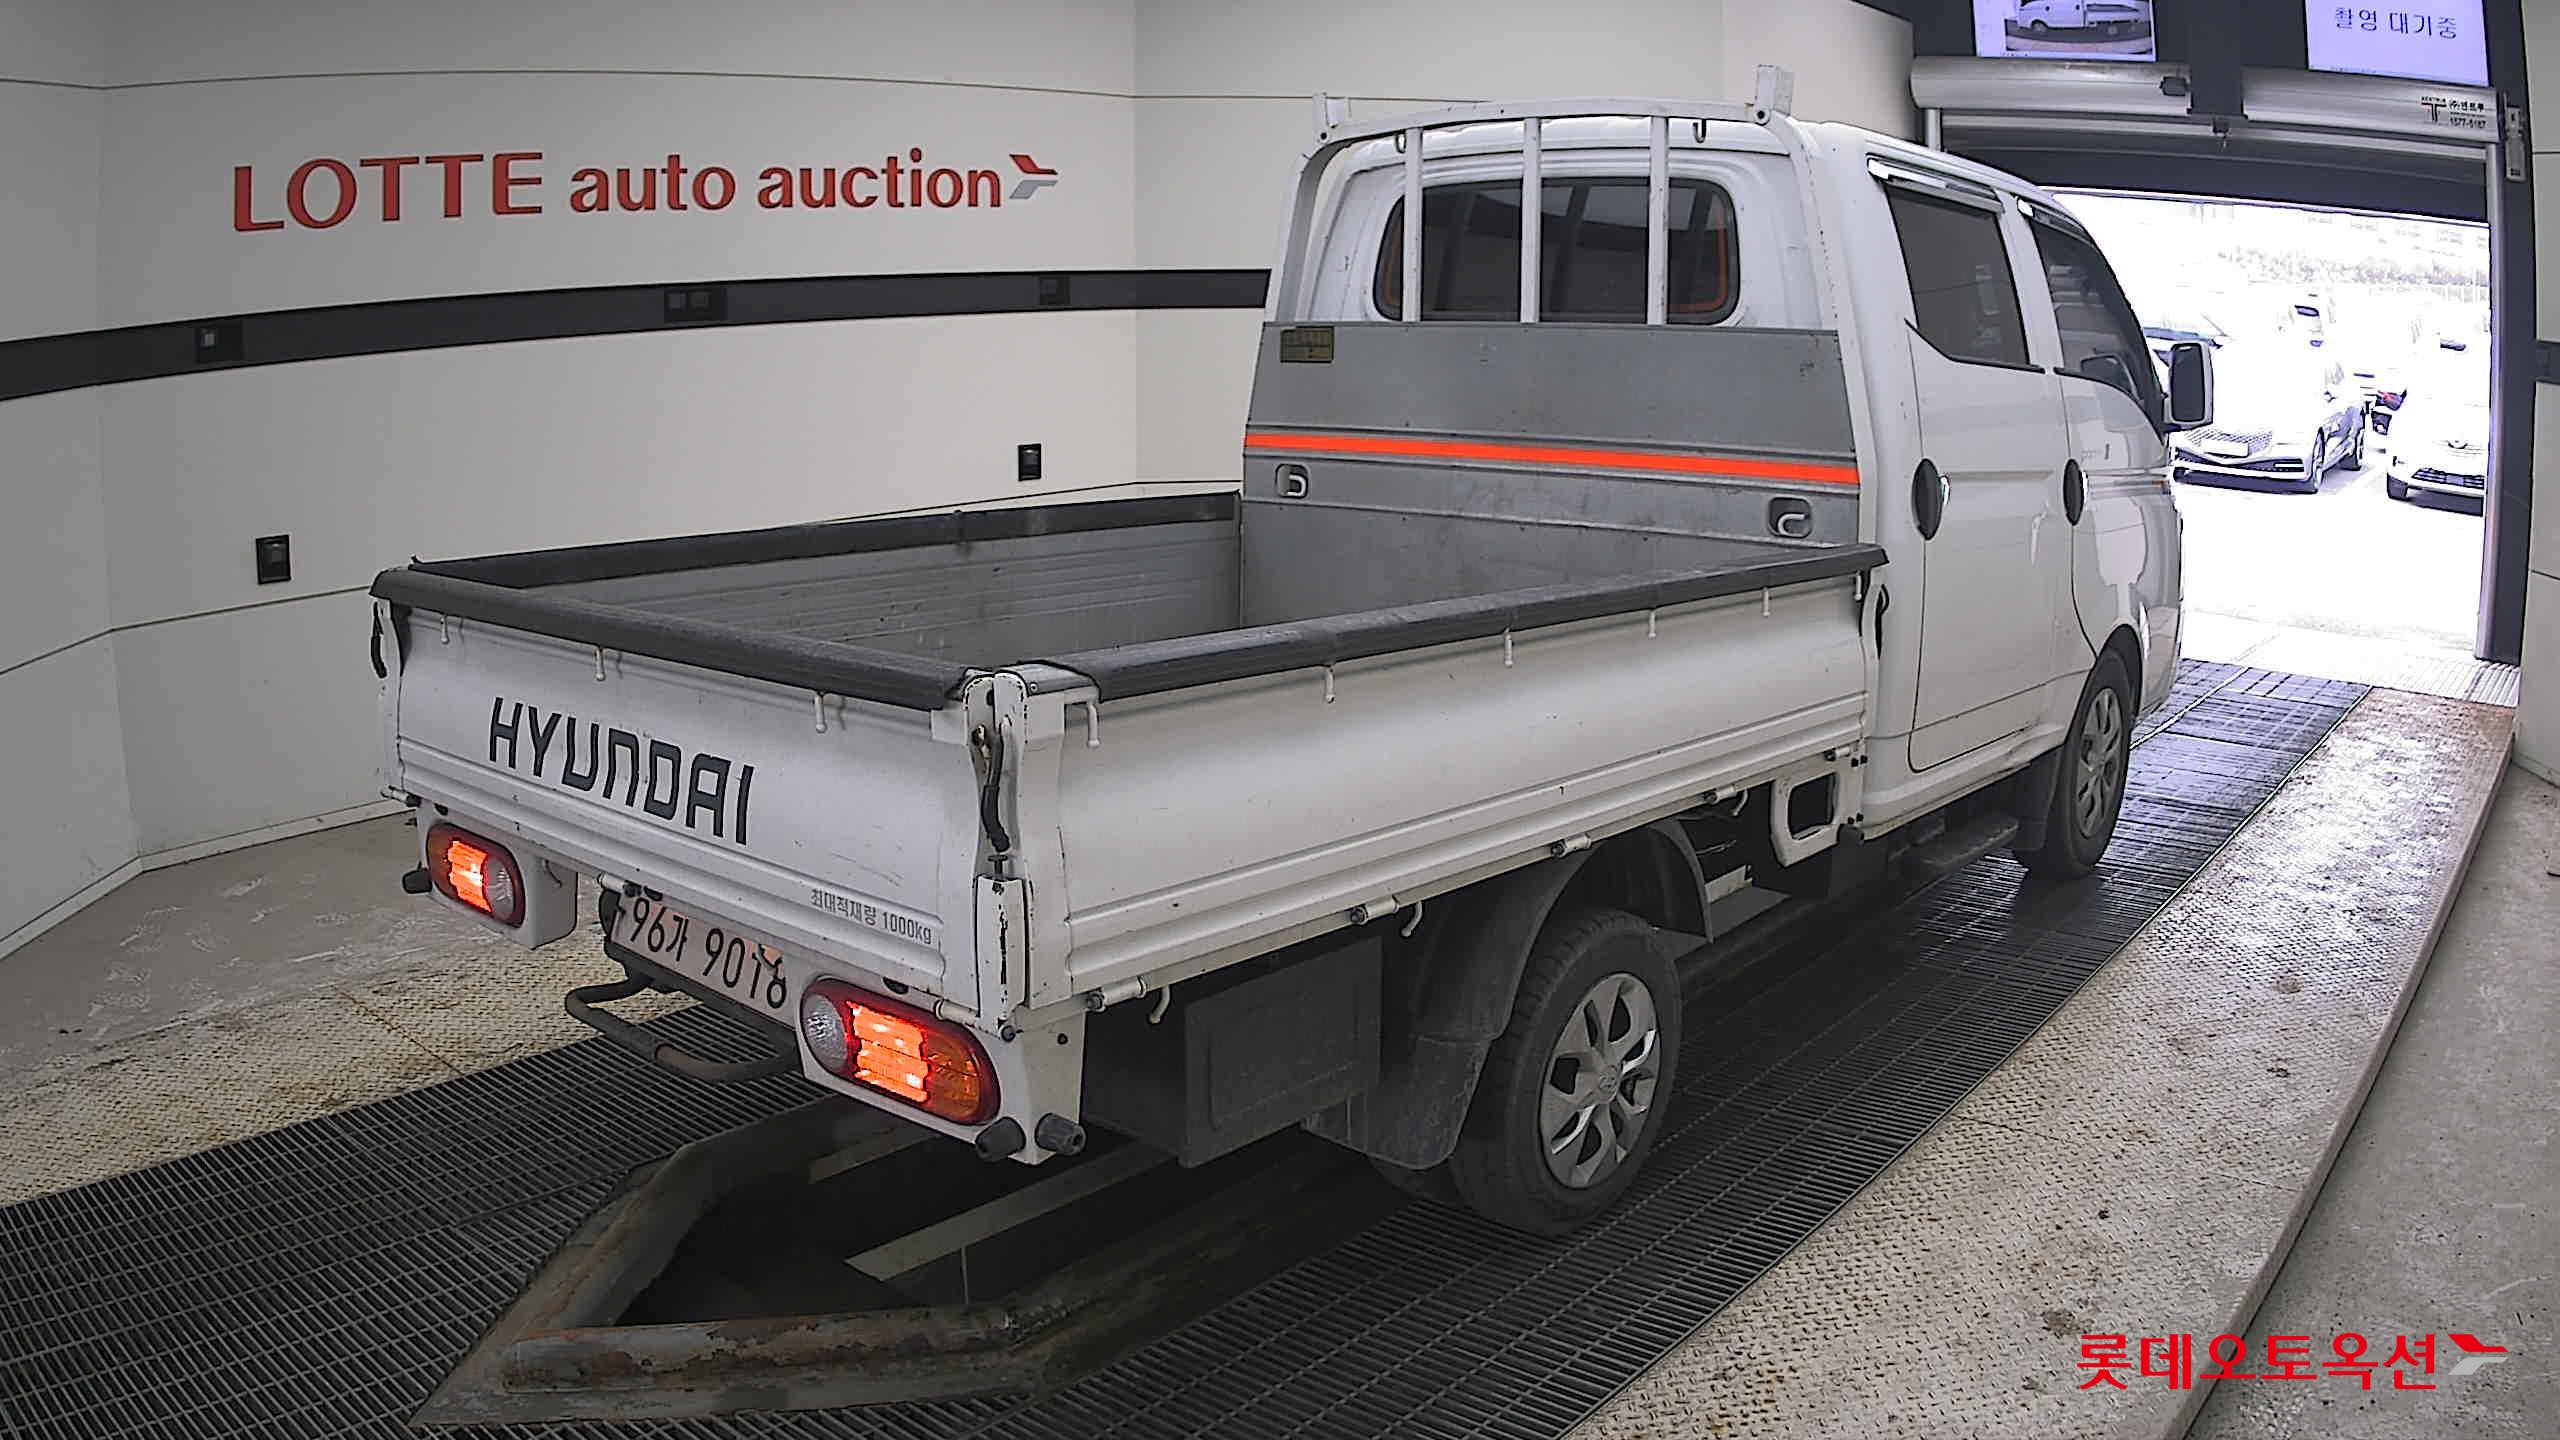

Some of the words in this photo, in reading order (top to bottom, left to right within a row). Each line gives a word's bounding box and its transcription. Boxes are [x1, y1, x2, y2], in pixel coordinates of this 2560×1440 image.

[2389, 11, 2457, 40] 대기중
[234, 152, 542, 231] LOTTE
[571, 156, 737, 213] auto
[757, 148, 1001, 208] auction
[489, 696, 755, 846] HYUNDAI
[630, 897, 689, 962] 96가
[811, 888, 877, 926] 최대적재량
[882, 911, 932, 945] 1000kg
